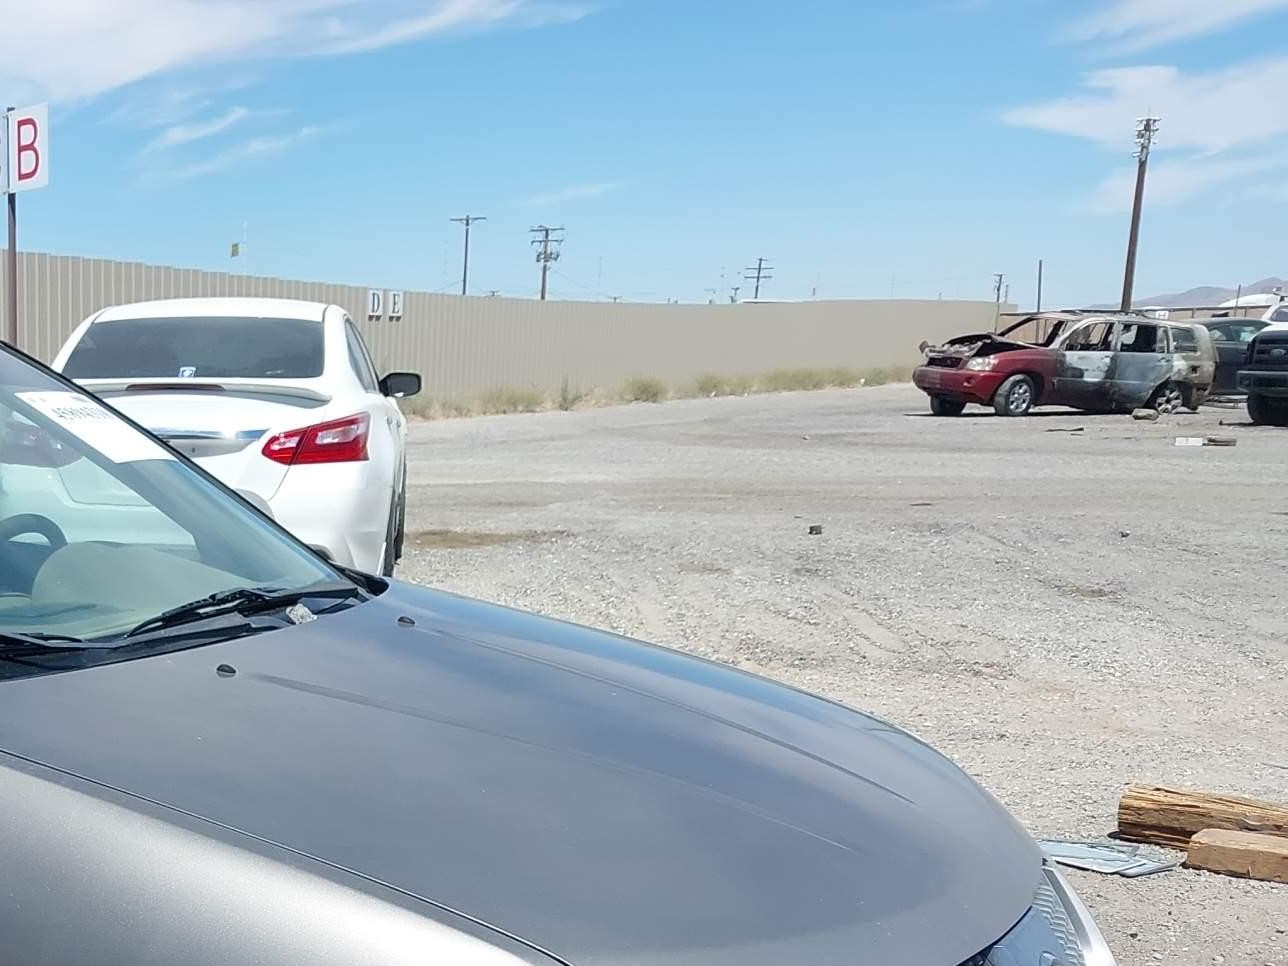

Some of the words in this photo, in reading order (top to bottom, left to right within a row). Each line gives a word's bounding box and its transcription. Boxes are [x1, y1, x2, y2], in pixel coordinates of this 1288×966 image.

[17, 118, 40, 181] B
[371, 292, 381, 313] D
[392, 293, 401, 314] E
